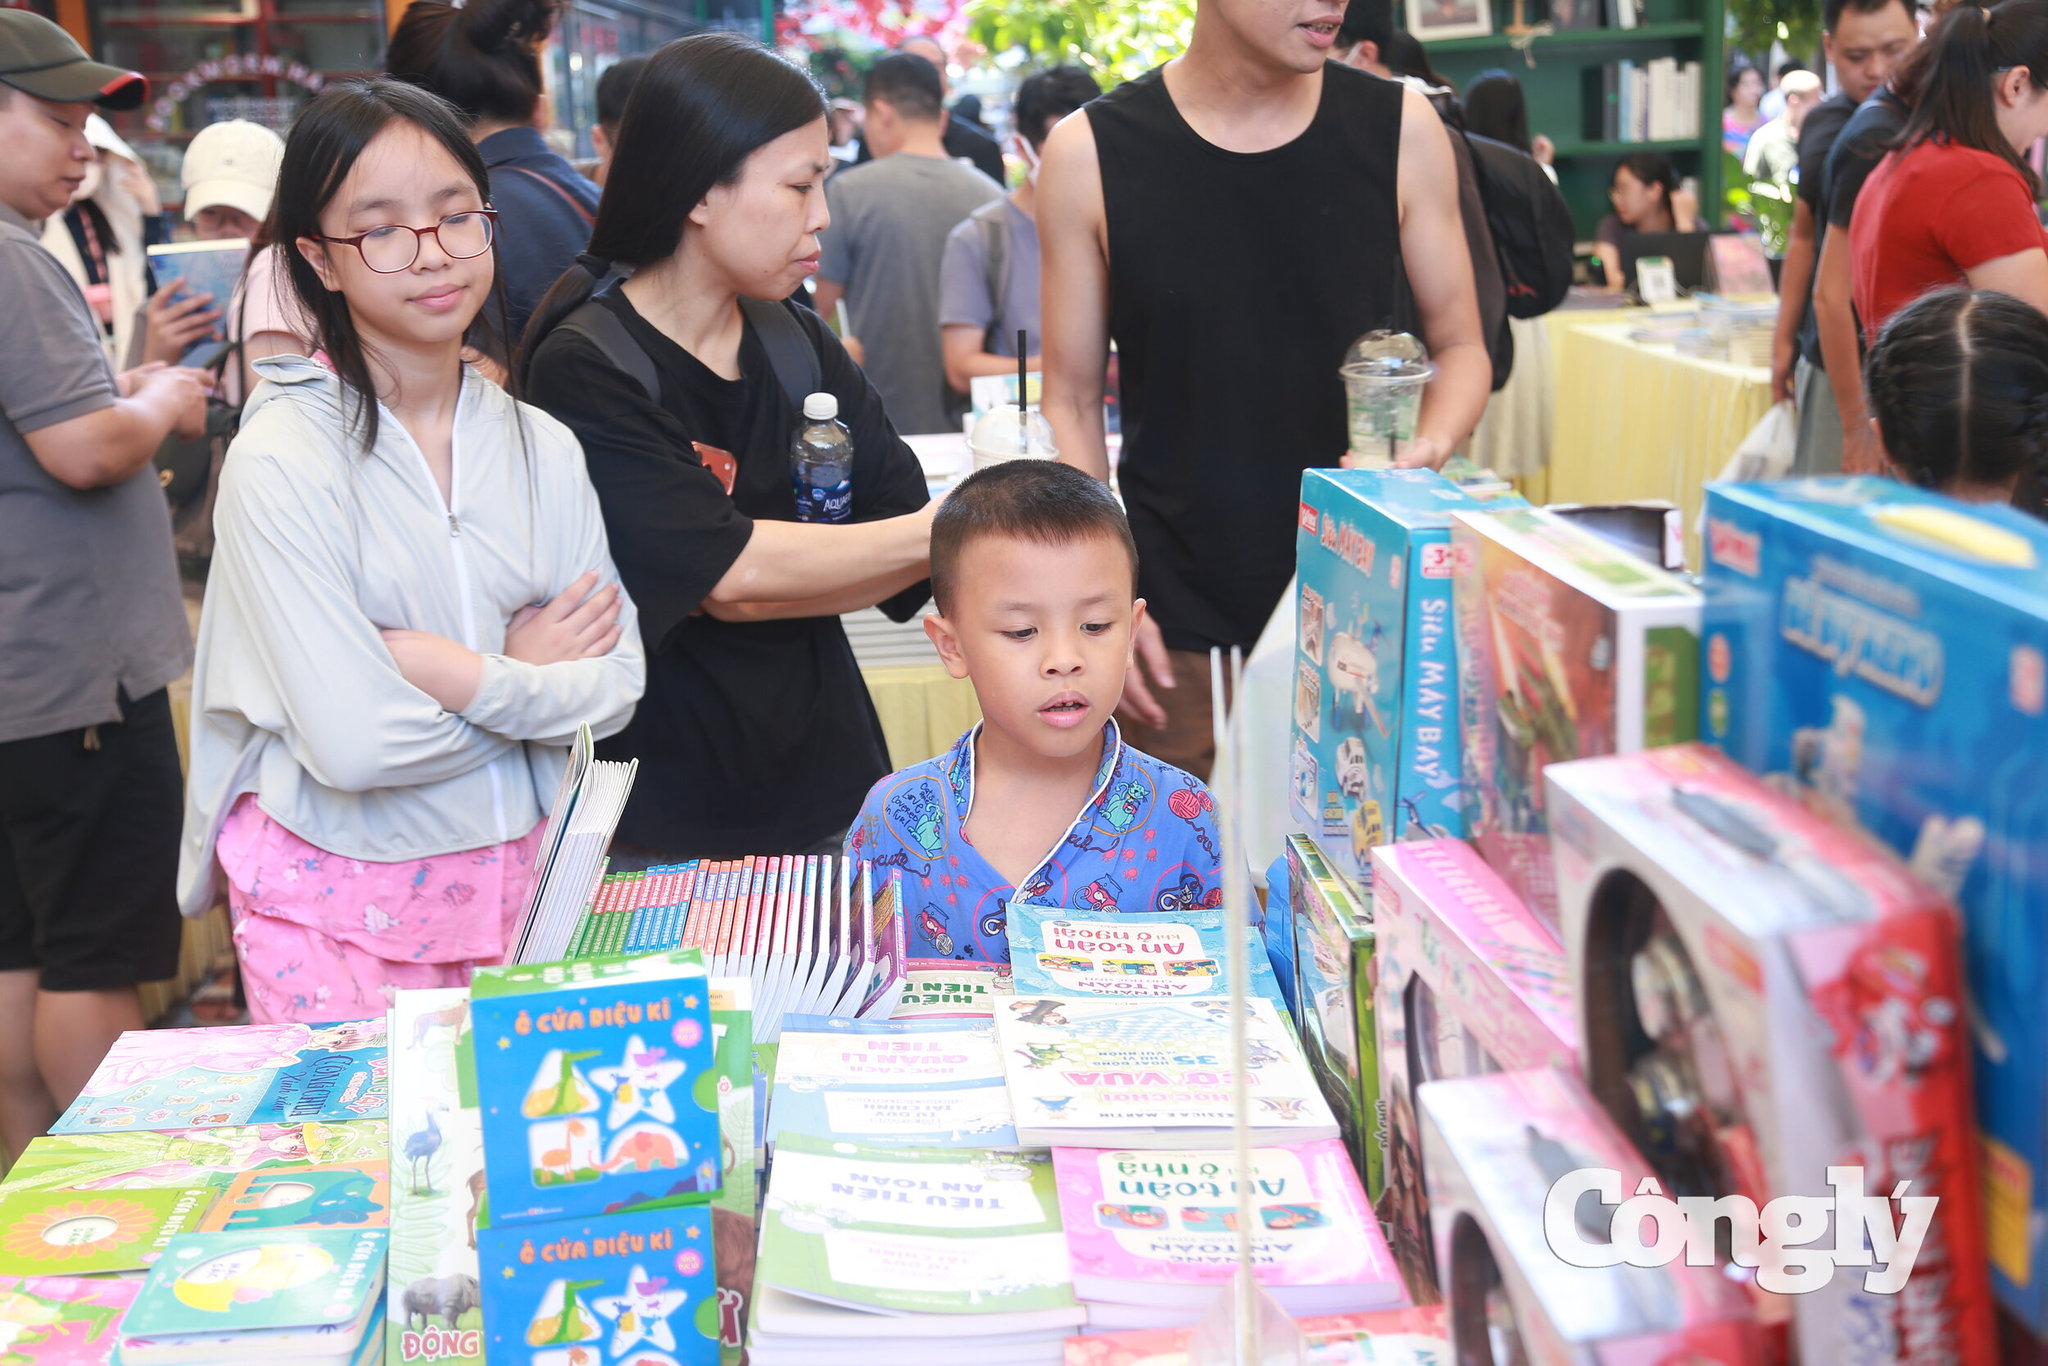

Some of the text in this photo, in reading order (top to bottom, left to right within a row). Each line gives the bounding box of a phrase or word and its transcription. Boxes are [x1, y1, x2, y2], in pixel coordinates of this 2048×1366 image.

[1420, 598, 1447, 653] Siêu
[1418, 661, 1446, 720] MÁY
[1413, 726, 1442, 777] BAY
[1053, 927, 1129, 940] ngoài
[1054, 939, 1184, 955] An toàn
[514, 1011, 531, 1035] Ô
[537, 1006, 583, 1034] CỬA
[590, 1002, 642, 1031] DIỆU
[867, 1040, 942, 1053] TIỀN
[877, 1053, 968, 1067] QUẢN
[1173, 1055, 1217, 1066] 35
[1064, 1071, 1168, 1088] VUA
[1117, 1161, 1189, 1178] nhà
[1199, 1163, 1219, 1180] ở
[941, 1182, 983, 1194] AN
[1119, 1179, 1221, 1198] toàn
[519, 1240, 536, 1265] Ô
[541, 1236, 588, 1263] CỬA
[592, 1231, 645, 1261] DIỆU
[403, 1326, 479, 1360] ĐỘNG
